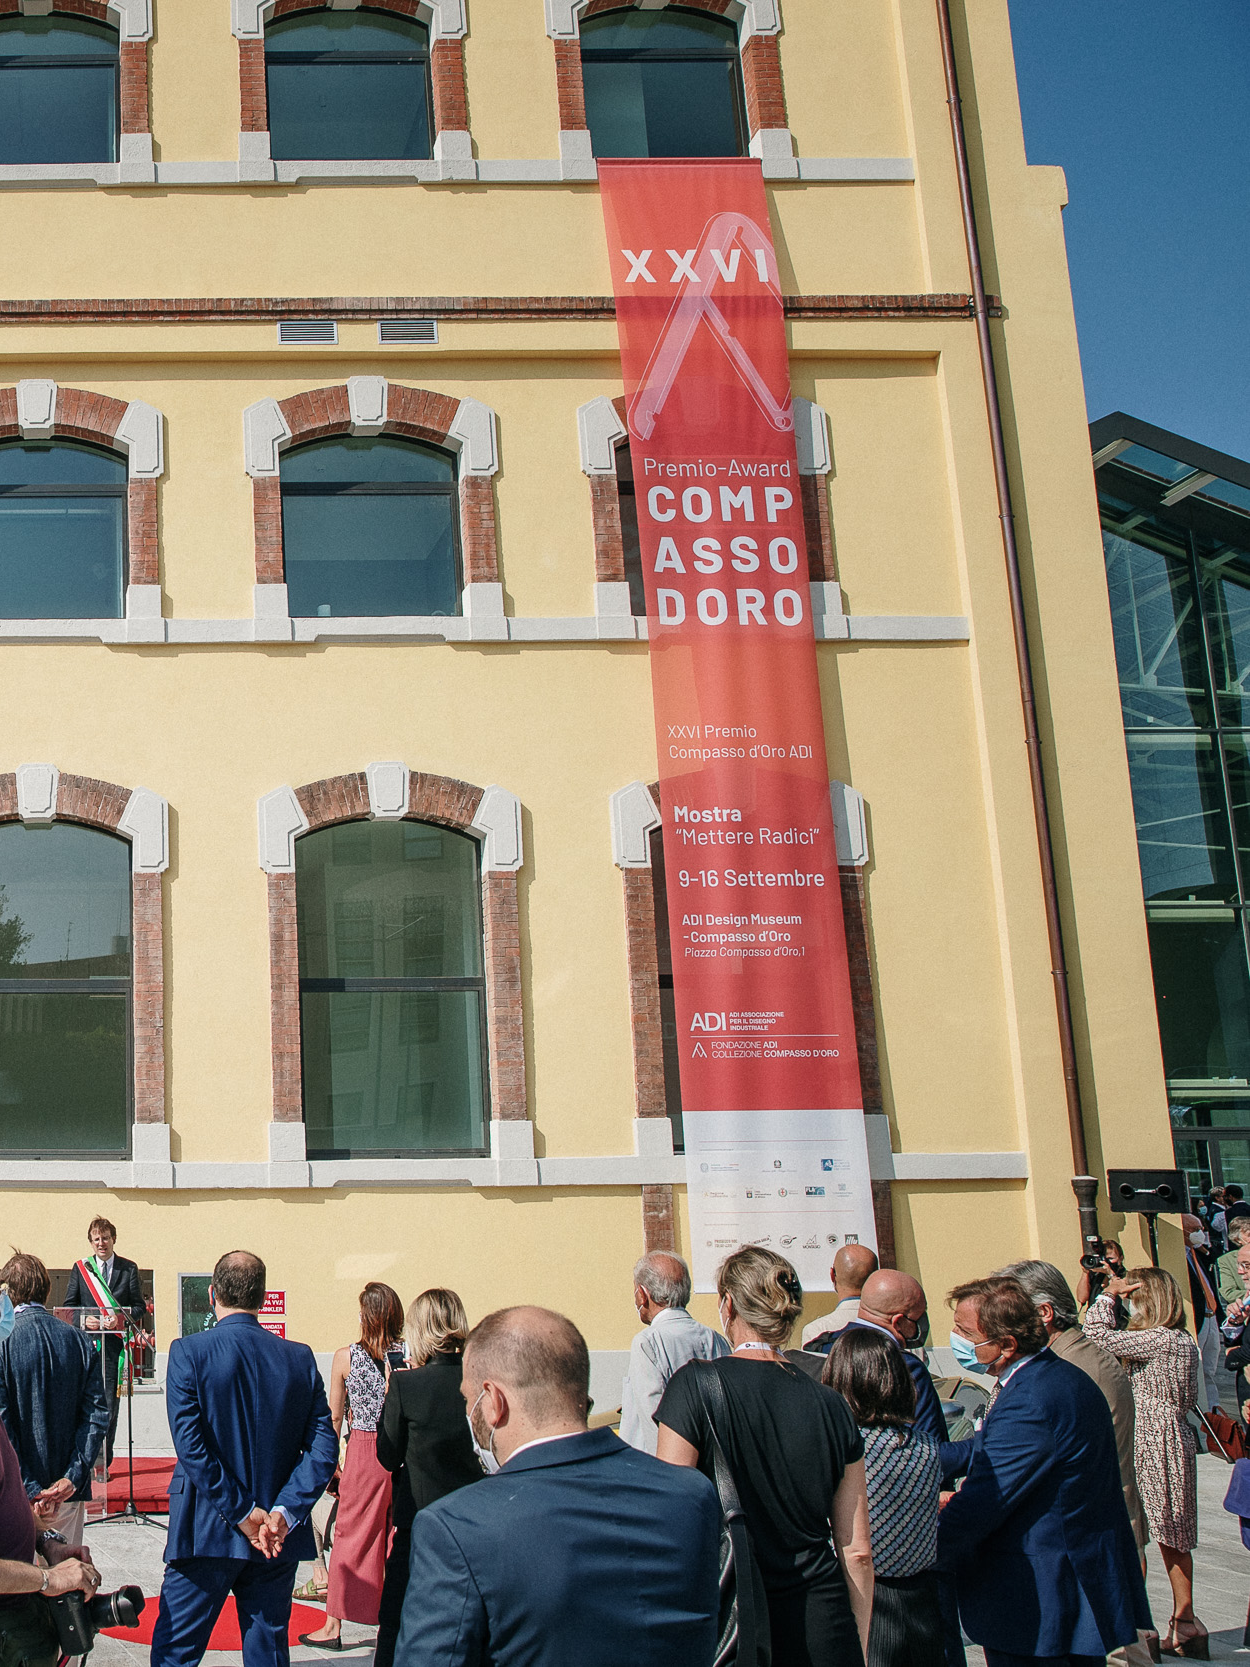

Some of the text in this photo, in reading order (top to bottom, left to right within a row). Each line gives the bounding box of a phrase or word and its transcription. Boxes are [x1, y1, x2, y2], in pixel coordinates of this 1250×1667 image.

[621, 248, 770, 284] XXVI
[643, 457, 791, 479] Premio-Award
[647, 484, 794, 524] COMP
[653, 535, 799, 575] ASSO
[657, 586, 805, 627] DORO
[667, 724, 757, 739] XXVI Premio
[669, 744, 813, 762] Compasso d'Oro ADI
[673, 805, 742, 823] Mostra
[675, 827, 821, 846] "Mettere Radici"
[678, 869, 825, 888] 9-16 Settembre
[681, 913, 802, 927] ADI Design Museum
[758, 930, 791, 942] d'Oro
[684, 947, 717, 958] Piazza
[719, 946, 771, 959] Compasso
[690, 1012, 727, 1032] ADI
[711, 1041, 778, 1049] FONDAZIONE ADI
[712, 1049, 840, 1059] COLLEZIONE COMPASSO D'ORO
